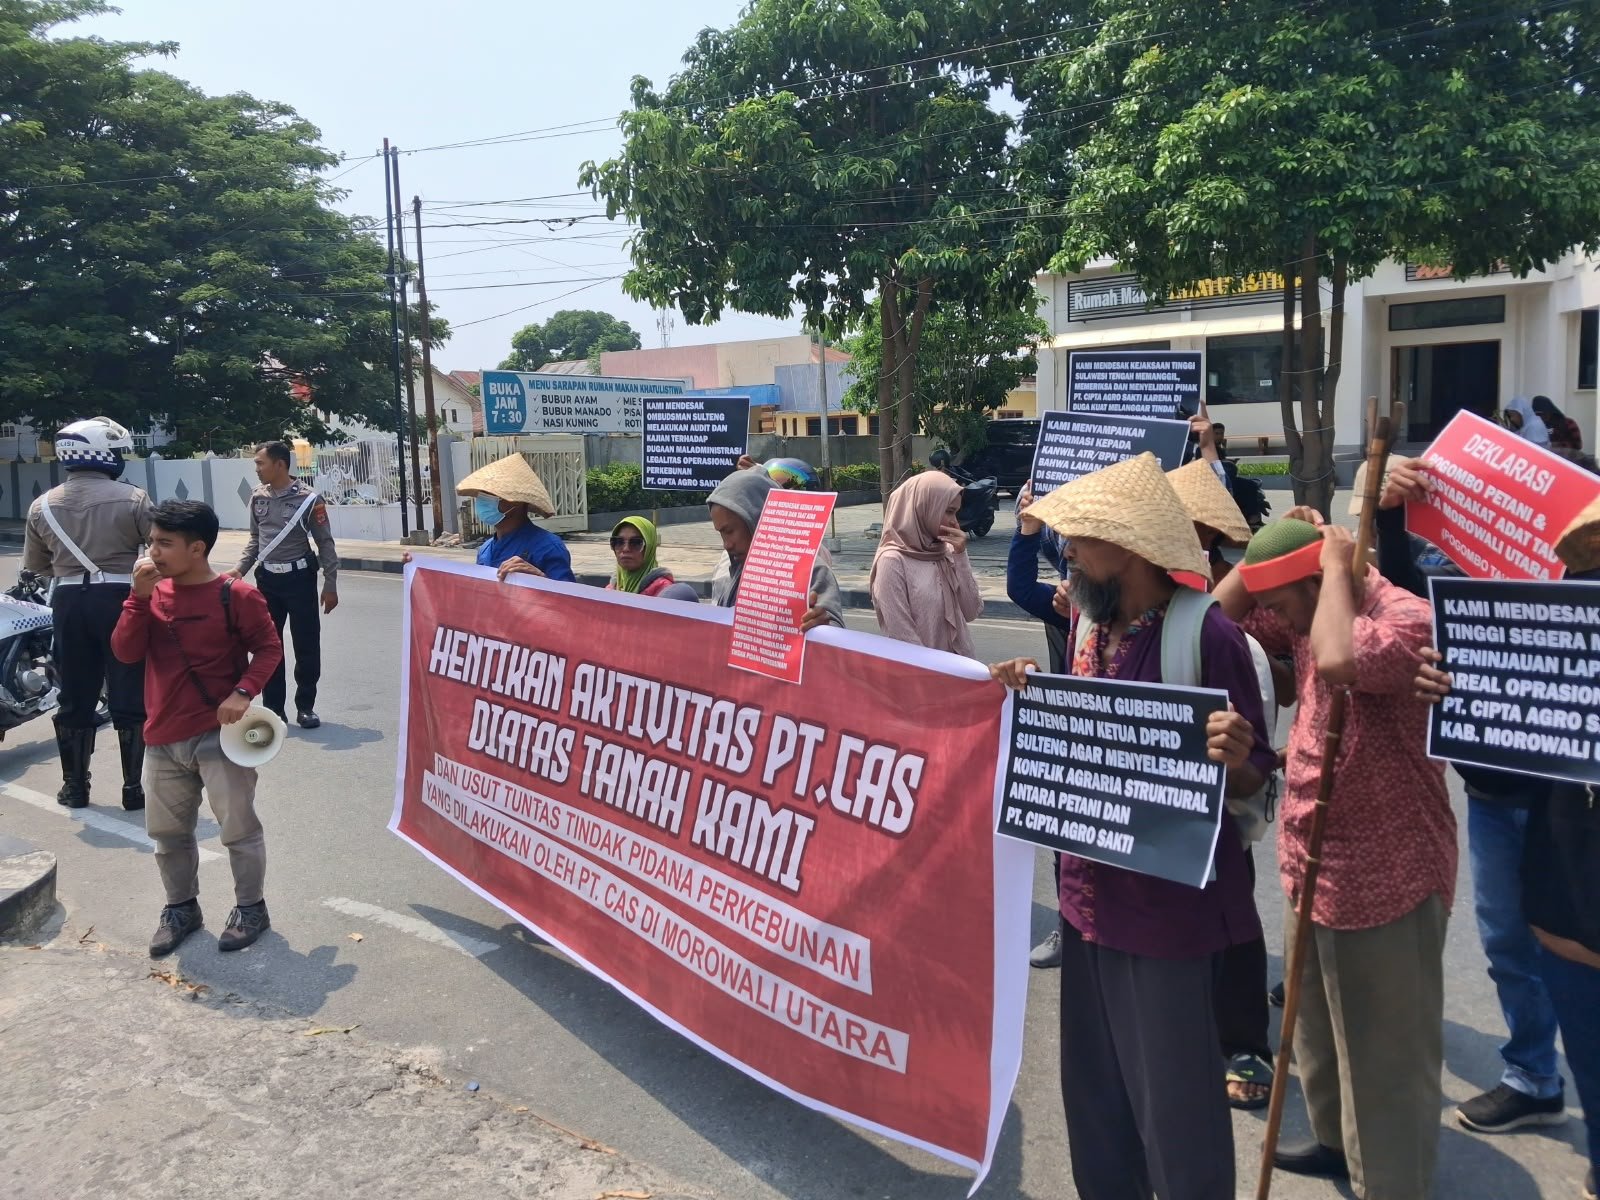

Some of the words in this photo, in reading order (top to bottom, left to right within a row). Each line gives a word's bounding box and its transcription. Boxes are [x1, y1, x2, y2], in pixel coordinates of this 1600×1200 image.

[1074, 289, 1118, 310] Rumah
[1130, 362, 1170, 370] KEJAKSAAN
[1172, 362, 1195, 370] TINGGI
[1136, 373, 1180, 382] MEMANGGIL,
[489, 382, 521, 395] BUKA
[529, 380, 550, 390] MENU
[552, 381, 587, 391] SARAPAN
[589, 382, 613, 392] RUMAH
[615, 383, 639, 393] MAKAN
[640, 384, 683, 395] KHATULISTIWA
[1129, 383, 1174, 391] MENYELIDIKI
[1175, 384, 1198, 392] PIHAK
[495, 397, 517, 409] JAM
[541, 395, 572, 404] BUBUR
[574, 396, 598, 404] AYAM
[623, 397, 637, 405] MIE
[646, 402, 664, 410] KAMI
[666, 402, 704, 410] MENDESAK
[1084, 393, 1101, 401] CIPTA
[1103, 393, 1121, 401] AGRO
[1122, 394, 1142, 402] SAKTI
[1143, 394, 1172, 402] KARENA
[1174, 394, 1182, 402] DI
[542, 407, 573, 416] BUBUR
[574, 407, 612, 416] MANADO
[1072, 403, 1090, 411] DUGA
[1108, 404, 1151, 412] MELANGGAR
[543, 419, 564, 427] NASI
[566, 419, 599, 428] KUNING
[646, 413, 692, 421] OMBUDSMAN
[692, 413, 725, 421] SULTENG
[646, 423, 689, 432] MELAKUKAN
[690, 424, 711, 432] AUDIT
[712, 424, 728, 432] DAN
[1047, 420, 1070, 430] KAMI
[1072, 422, 1146, 438] MENYAMPAIKAN
[646, 434, 670, 442] KAJIAN
[671, 435, 708, 443] TERHADAP
[1044, 433, 1094, 446] INFORMASI
[1096, 438, 1132, 450] KEPADA
[646, 445, 674, 453] DUGAAN
[676, 446, 742, 455] MALADMINISTRASI
[1042, 445, 1076, 456] KANWIL
[1077, 450, 1118, 462] ATR/BPN
[646, 456, 681, 464] LEGALITAS
[683, 457, 734, 466] OPERASIONAL
[1038, 458, 1069, 470] BAHWA
[1462, 433, 1556, 496] DEKLARASI
[646, 466, 692, 475] PERKEBUNAN
[1036, 470, 1045, 479] DI
[1046, 471, 1082, 481] SEROBO
[646, 477, 656, 485] PT.
[657, 478, 677, 486] CIPTA
[678, 478, 698, 487] AGRO
[1484, 485, 1534, 523] PETANI
[1533, 513, 1547, 531] &
[1495, 516, 1533, 546] ADAT
[1442, 502, 1505, 555] MOROWALI
[1505, 547, 1550, 580] UTARA
[1441, 530, 1489, 571] (POGOMBO
[1444, 600, 1490, 618] KAMI
[1494, 602, 1600, 624] MENDESAK
[1445, 623, 1506, 643] TINGGI
[1509, 628, 1587, 650] SEGERA
[1446, 647, 1560, 674] PENINJAUAN
[1563, 657, 1600, 678] LAP
[428, 626, 567, 711] HENTIKAN
[569, 663, 761, 774] AKTIVITAS
[1505, 678, 1600, 706] OPRASION
[1045, 689, 1112, 714] MENDESAK
[1114, 697, 1194, 724] GUBERNUR
[1442, 696, 1467, 716] PT.
[1470, 699, 1522, 723] CIPTA
[1525, 706, 1583, 731] AGRO
[1018, 708, 1068, 732] SULTENG
[1070, 717, 1094, 737] DAN
[1097, 721, 1137, 744] KETUA
[1140, 728, 1181, 750] DPRD
[1440, 720, 1480, 743] KAB.
[1484, 726, 1591, 760] MOROWALI
[1016, 733, 1068, 756] SULTENG
[1070, 742, 1102, 764] AGAR
[1105, 749, 1218, 786] MENYELESAIKAN
[1013, 757, 1064, 784] KONFLIK
[1065, 767, 1122, 796] AGRARIA
[1124, 778, 1209, 814] STRUKTURAL
[467, 698, 576, 784] DIATAS
[580, 734, 691, 835] TANAH
[691, 778, 816, 893] KAMI
[1009, 782, 1056, 808] ANTARA
[1058, 791, 1102, 819] PETANI
[1103, 802, 1131, 826] DAN
[1005, 807, 1023, 826] PT.
[1025, 811, 1059, 836] CIPTA
[1061, 820, 1096, 844] AGRO
[1097, 831, 1135, 856] SAKTI
[437, 757, 459, 787] DAN
[461, 771, 501, 802] USUT
[504, 784, 562, 830] TUNTAS
[566, 811, 628, 862] TINDAK
[628, 840, 694, 898] PIDANA
[697, 875, 861, 982] PERKEBUNAN
[426, 779, 451, 815] YANG
[453, 798, 532, 860] DILAKUKAN
[534, 842, 575, 885] OLEH
[578, 866, 601, 901] PT.
[604, 883, 639, 925] CAS
[640, 904, 660, 939] DI
[661, 917, 779, 1014] MOROWALI
[786, 990, 896, 1067] UTARA
